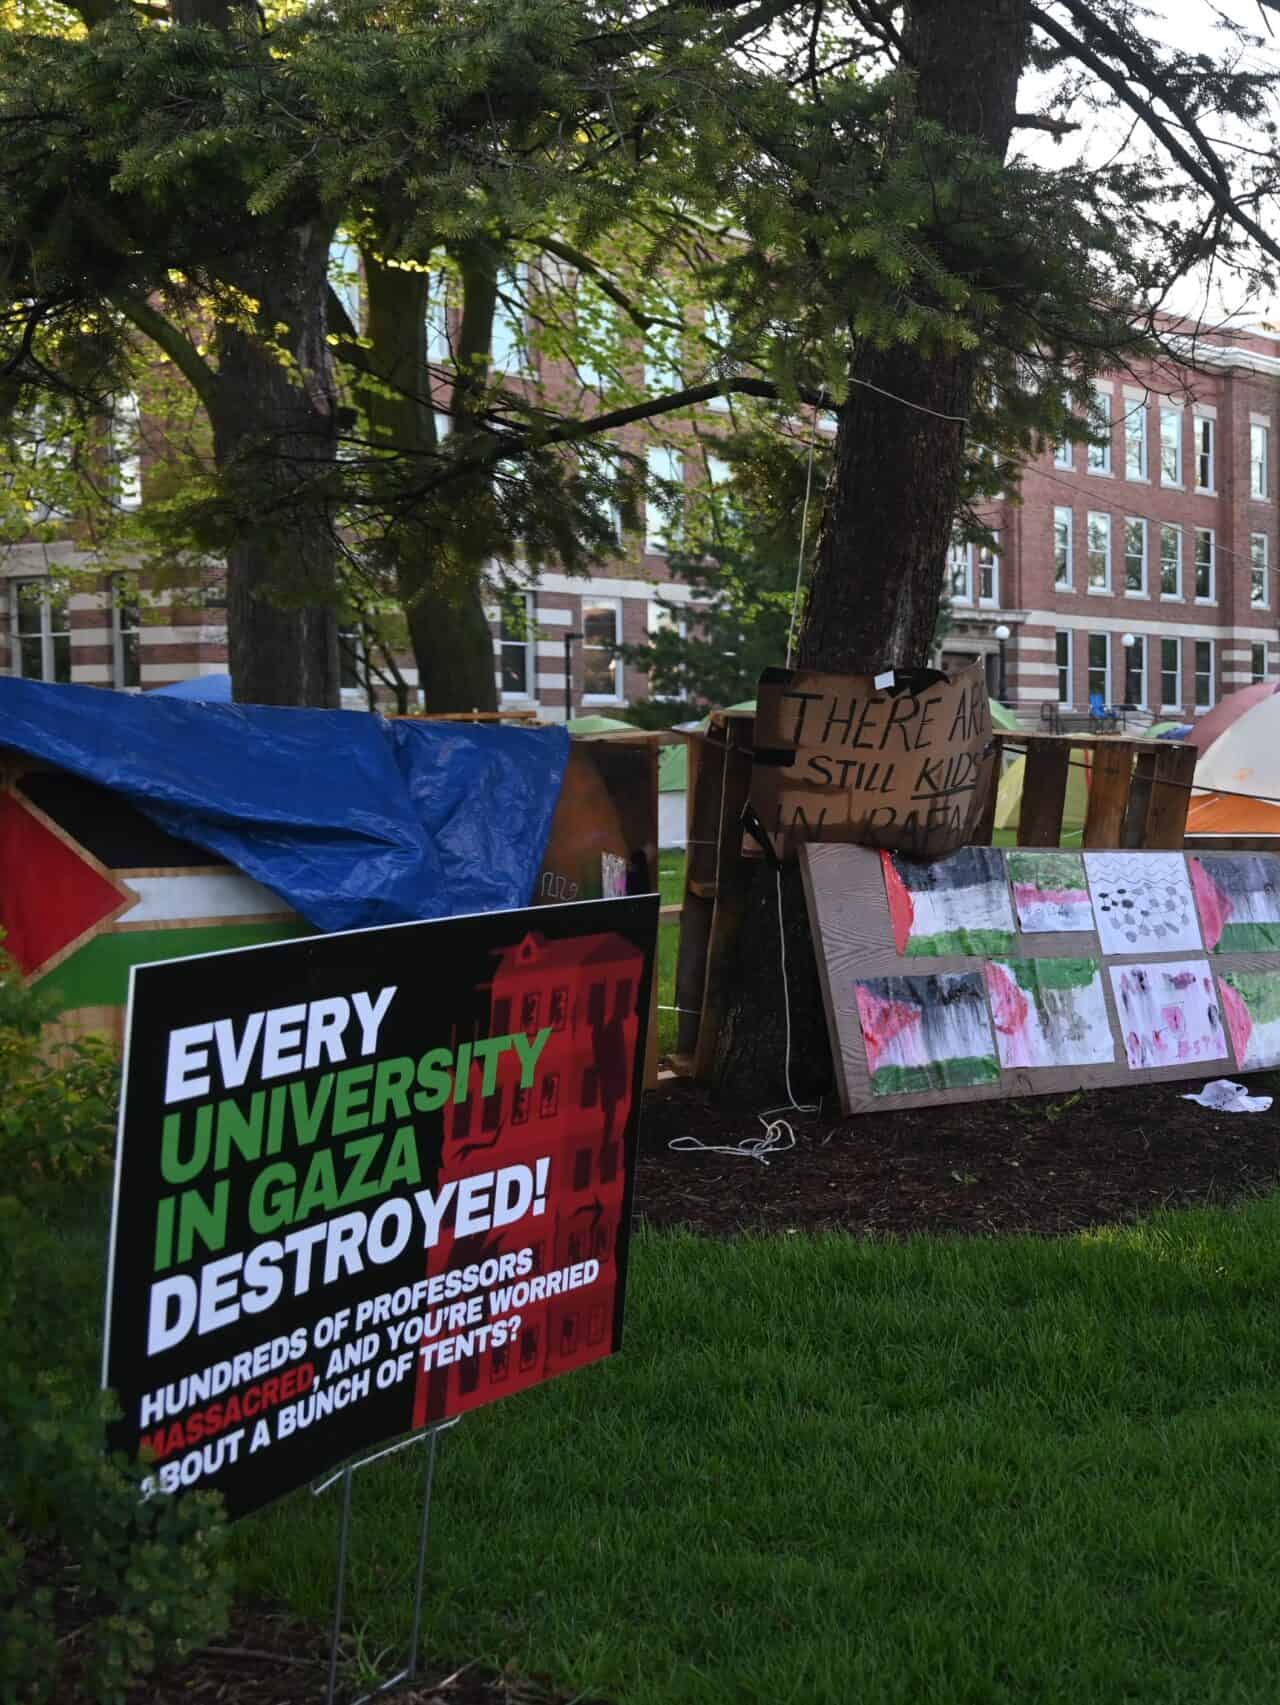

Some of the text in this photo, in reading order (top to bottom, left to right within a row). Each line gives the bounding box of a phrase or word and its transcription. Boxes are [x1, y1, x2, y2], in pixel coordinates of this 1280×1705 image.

[783, 693, 942, 750] THERE
[807, 752, 978, 793] STILL KIDS
[161, 1028, 552, 1184] UNIVERSITY
[164, 986, 397, 1104] EVERY
[147, 1157, 551, 1356] DESTROYED!
[153, 1125, 421, 1271] IN GAZA
[139, 1259, 599, 1461] MASSACRED, AND YOU'RE WORRIED
[140, 1248, 533, 1428] HUNDREDS OF PROFESSORS
[250, 1418, 271, 1454] A
[277, 1369, 370, 1439] BUNCH
[376, 1352, 413, 1389] OF
[420, 1315, 521, 1372] TENTS?
